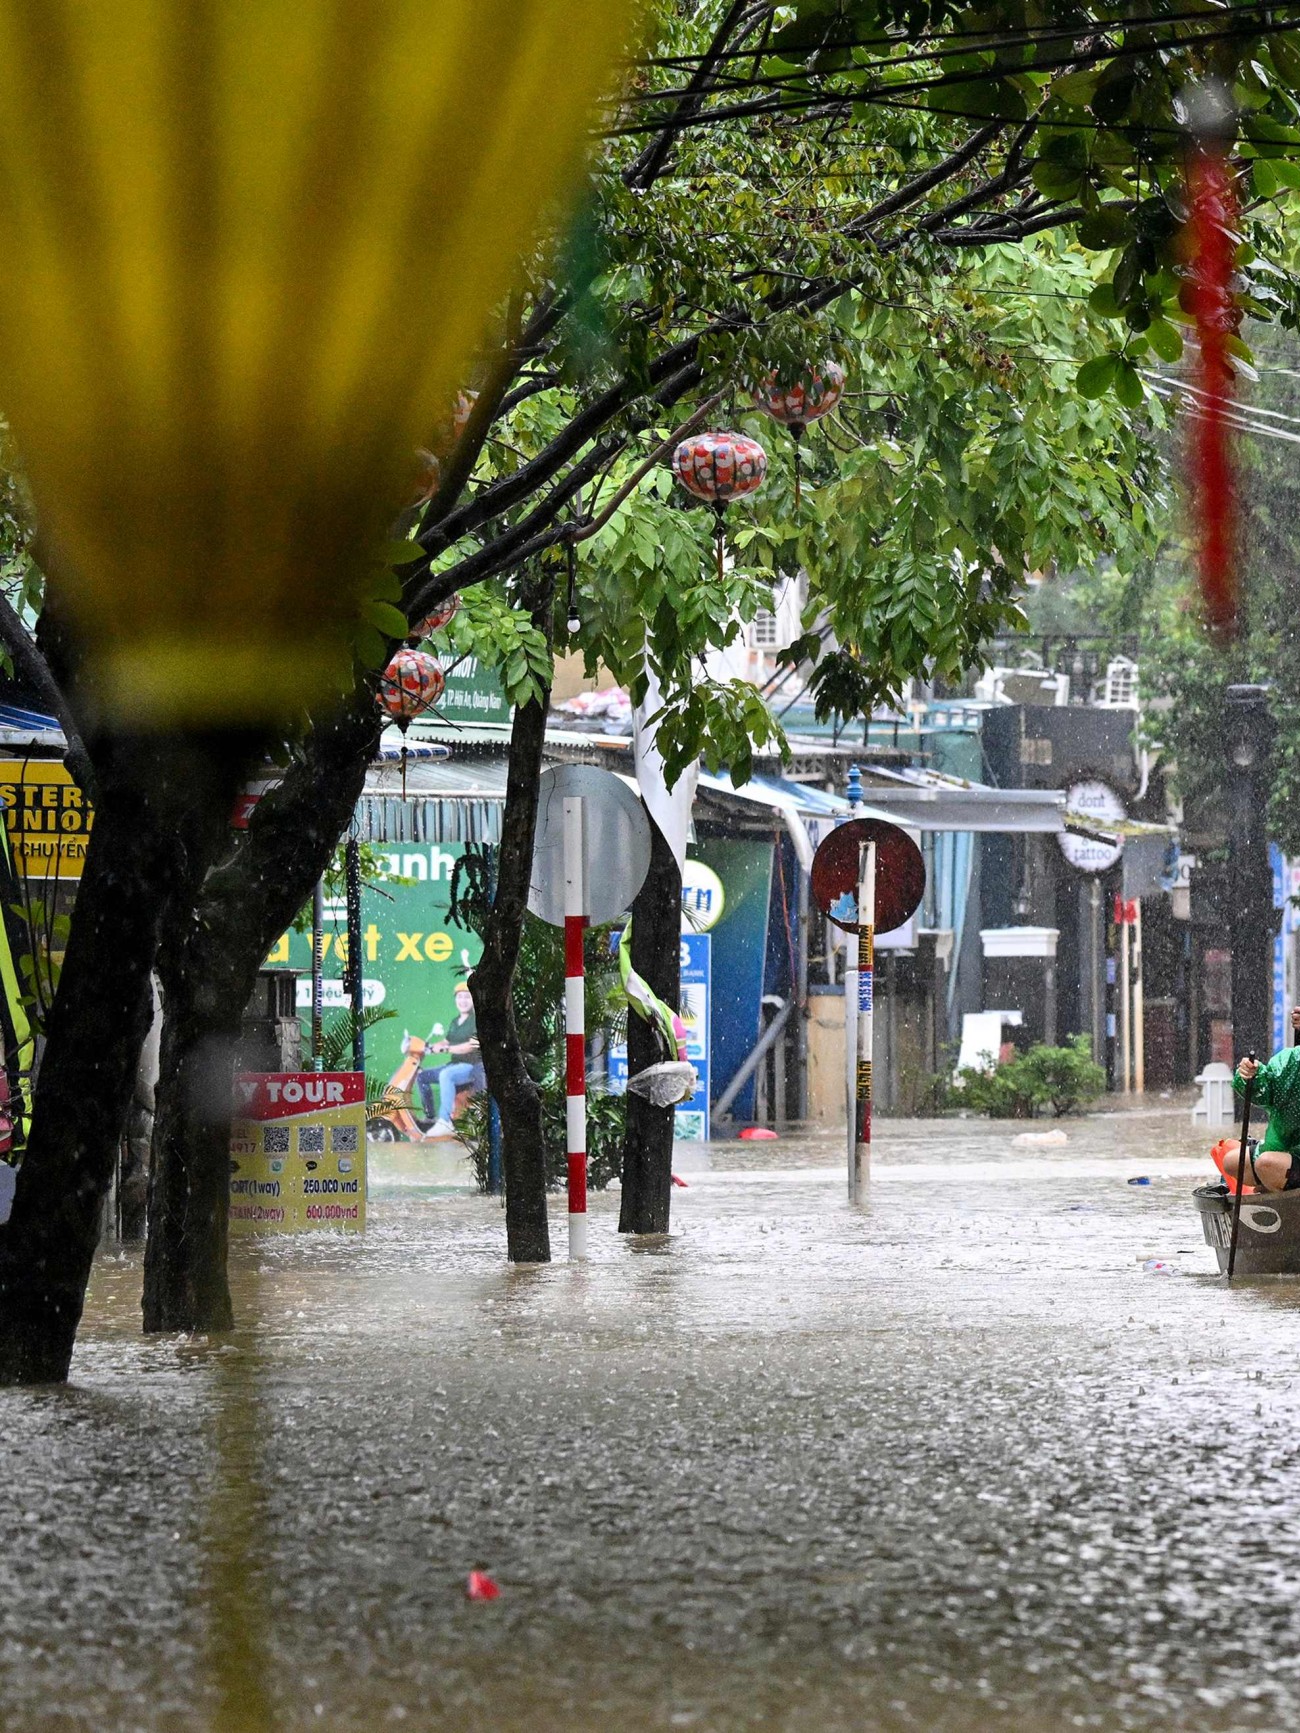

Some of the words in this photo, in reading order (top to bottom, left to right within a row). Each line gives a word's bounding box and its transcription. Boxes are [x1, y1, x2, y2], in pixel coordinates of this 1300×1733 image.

[0, 785, 94, 808] STER
[1074, 848, 1112, 862] tattoo
[394, 931, 454, 962] xe
[266, 1081, 345, 1103] TOUR
[303, 1179, 338, 1194] 250.000
